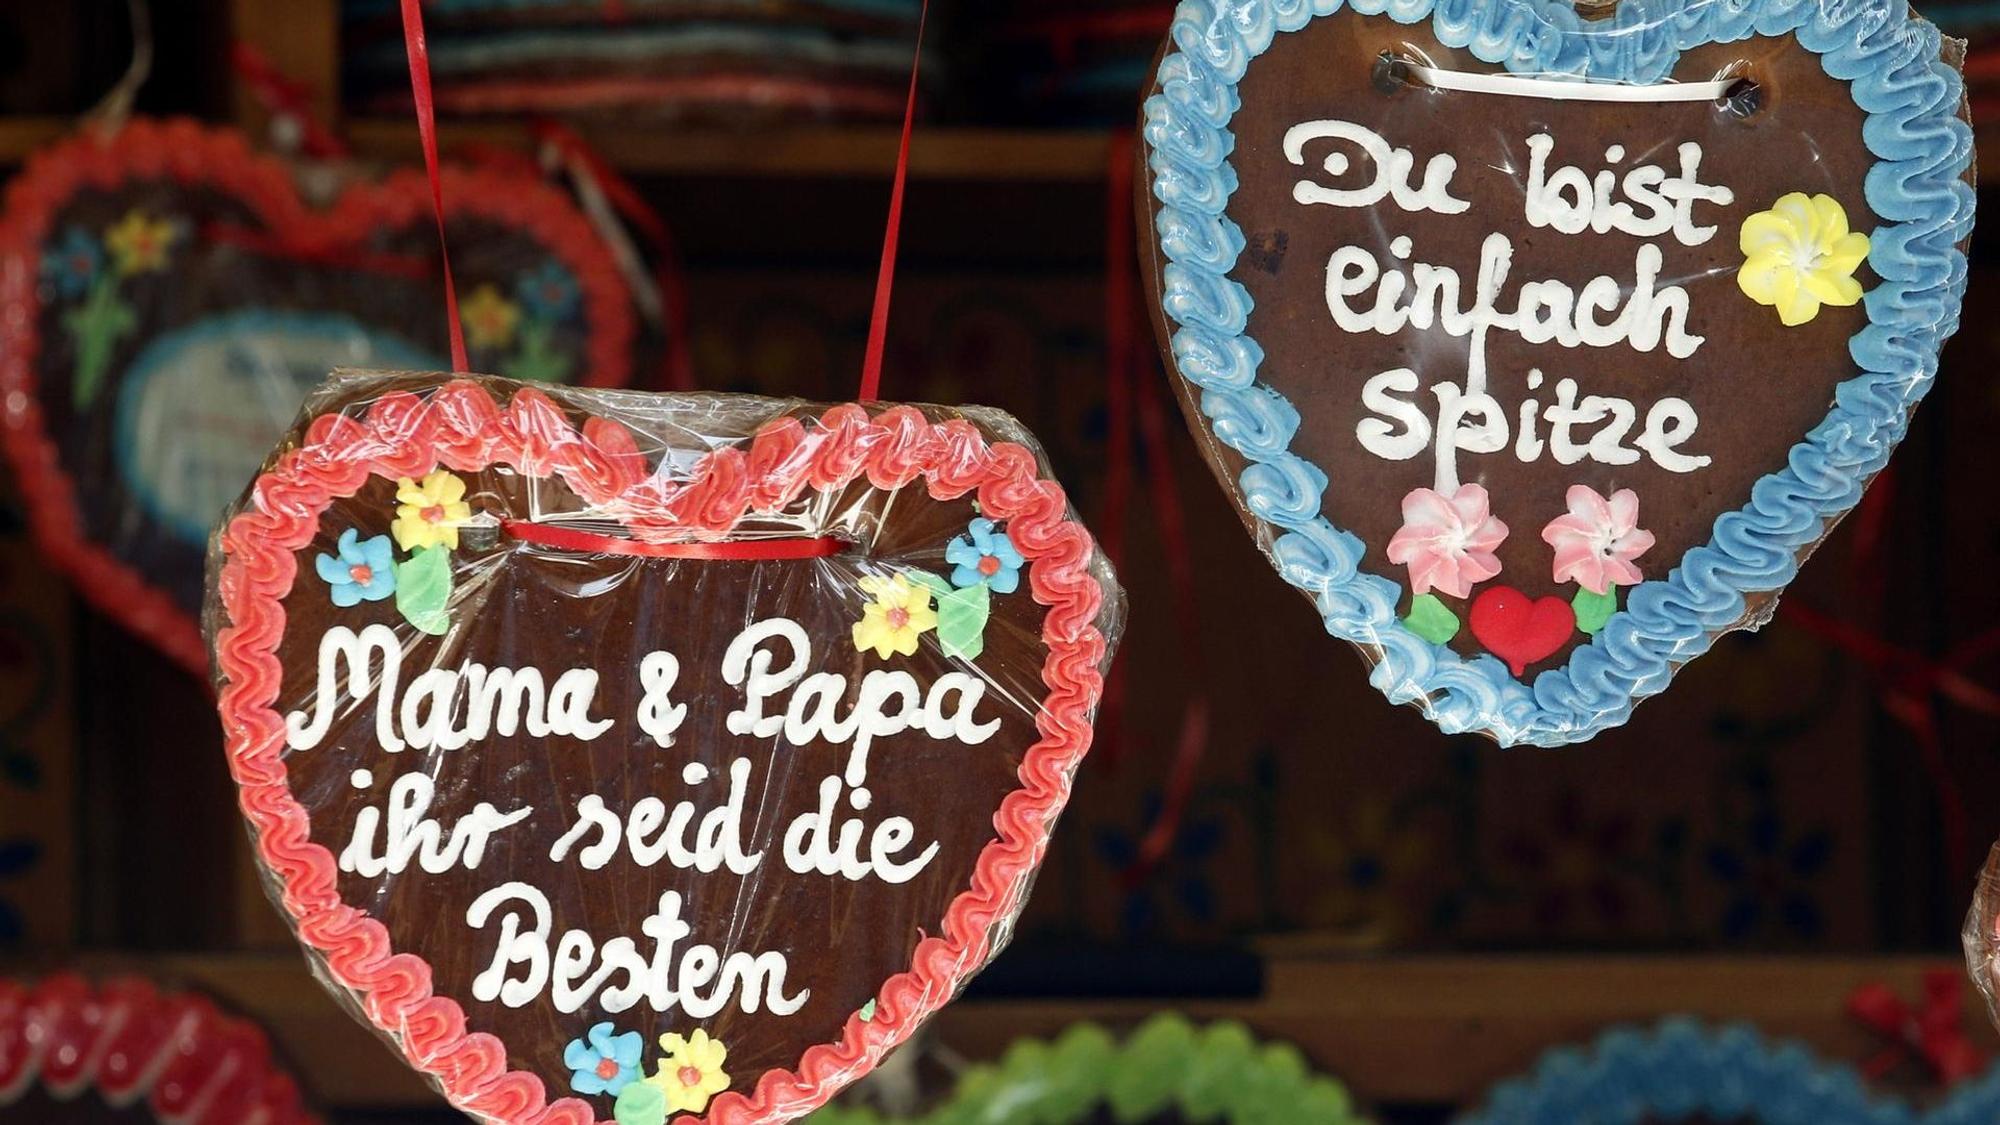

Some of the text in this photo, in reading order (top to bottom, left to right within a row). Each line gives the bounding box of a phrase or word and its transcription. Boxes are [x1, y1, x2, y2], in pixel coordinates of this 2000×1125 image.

[1283, 119, 1734, 246] Du bist
[1325, 232, 1705, 393] einfach
[284, 617, 1002, 789] Mama & Papa
[338, 757, 940, 883] ihr seid die
[466, 881, 810, 1018] Besten
